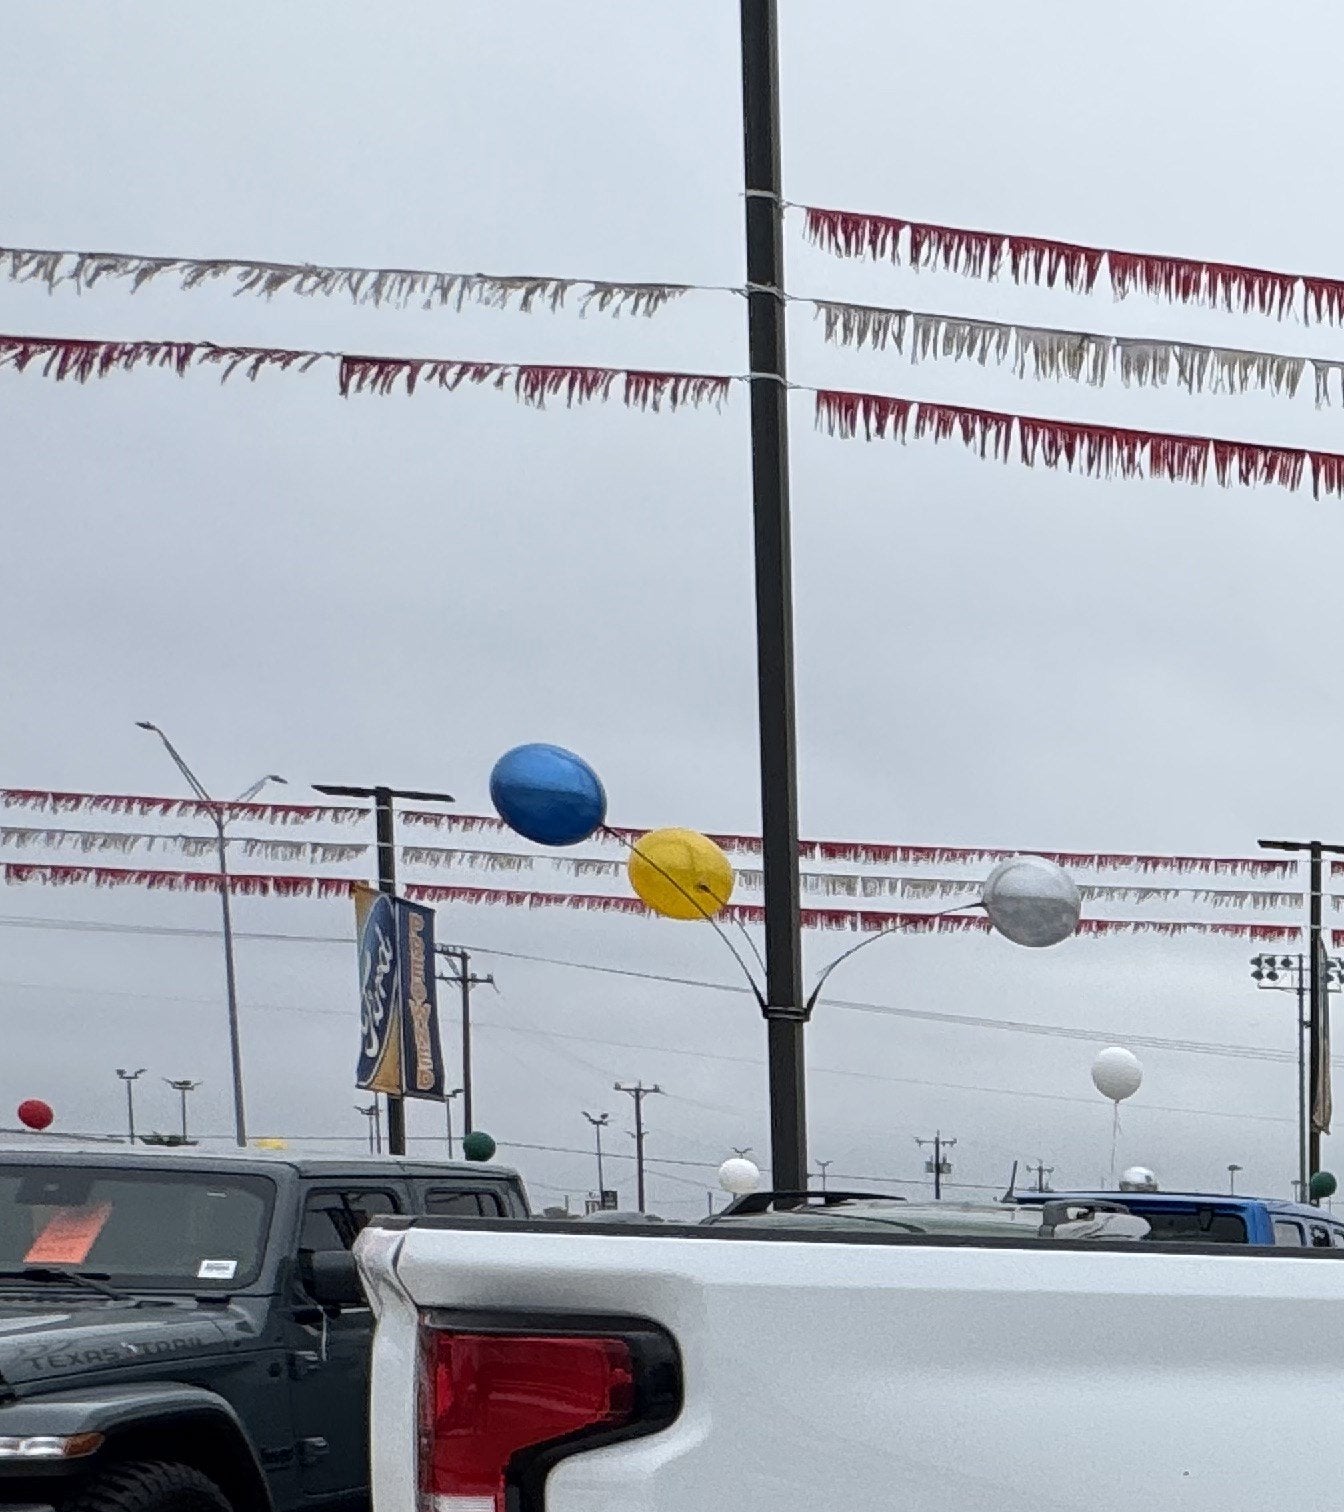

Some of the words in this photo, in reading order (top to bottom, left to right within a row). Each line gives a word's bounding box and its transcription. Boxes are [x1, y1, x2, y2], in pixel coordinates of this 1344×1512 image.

[361, 924, 393, 1058] Ford
[408, 912, 435, 1090] PREOWNED
[21, 1347, 119, 1371] TEXAS
